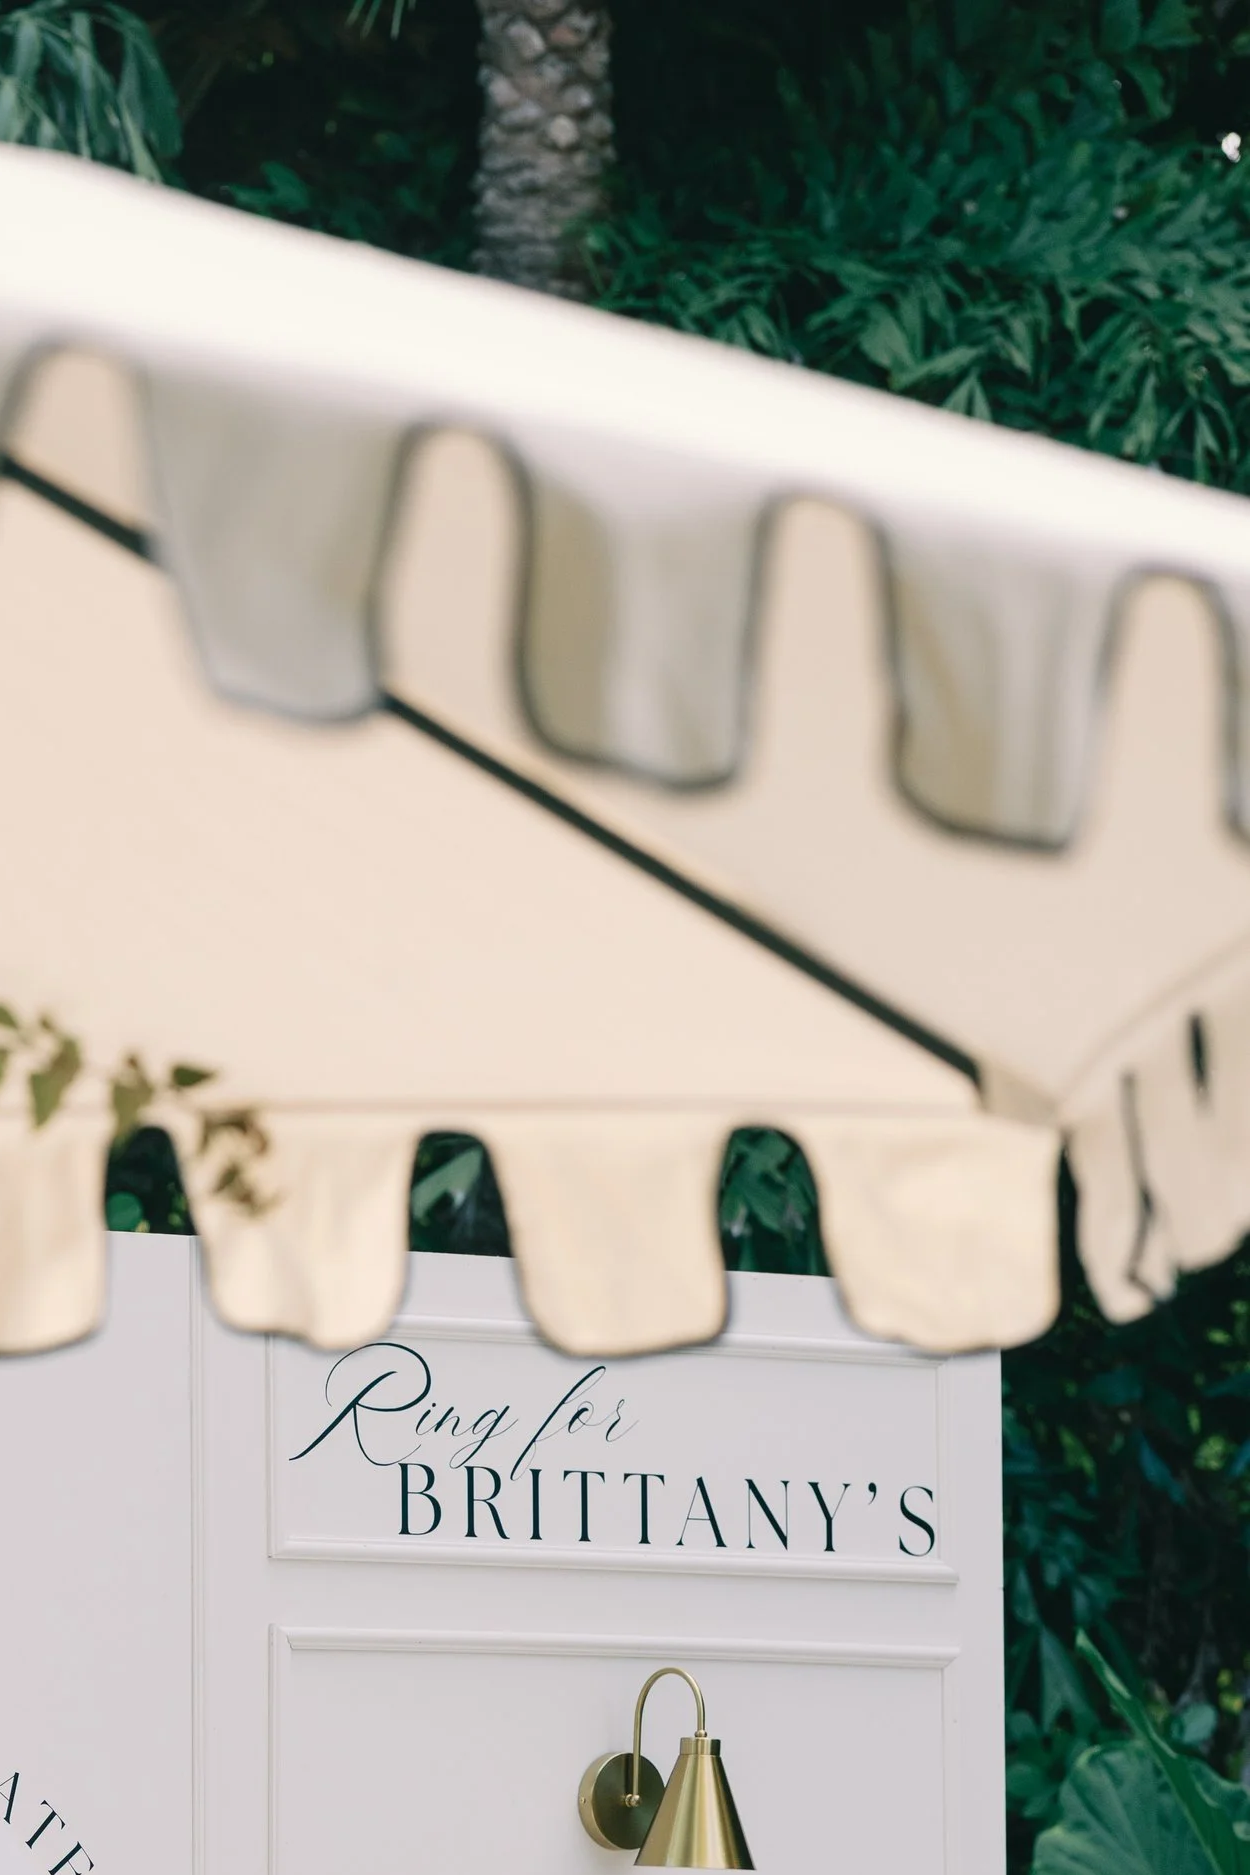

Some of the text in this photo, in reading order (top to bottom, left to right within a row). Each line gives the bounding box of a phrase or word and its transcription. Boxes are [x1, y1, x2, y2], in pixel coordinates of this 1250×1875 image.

[289, 1342, 639, 1481] Ring for
[398, 1462, 935, 1557] BRITTANY'S
